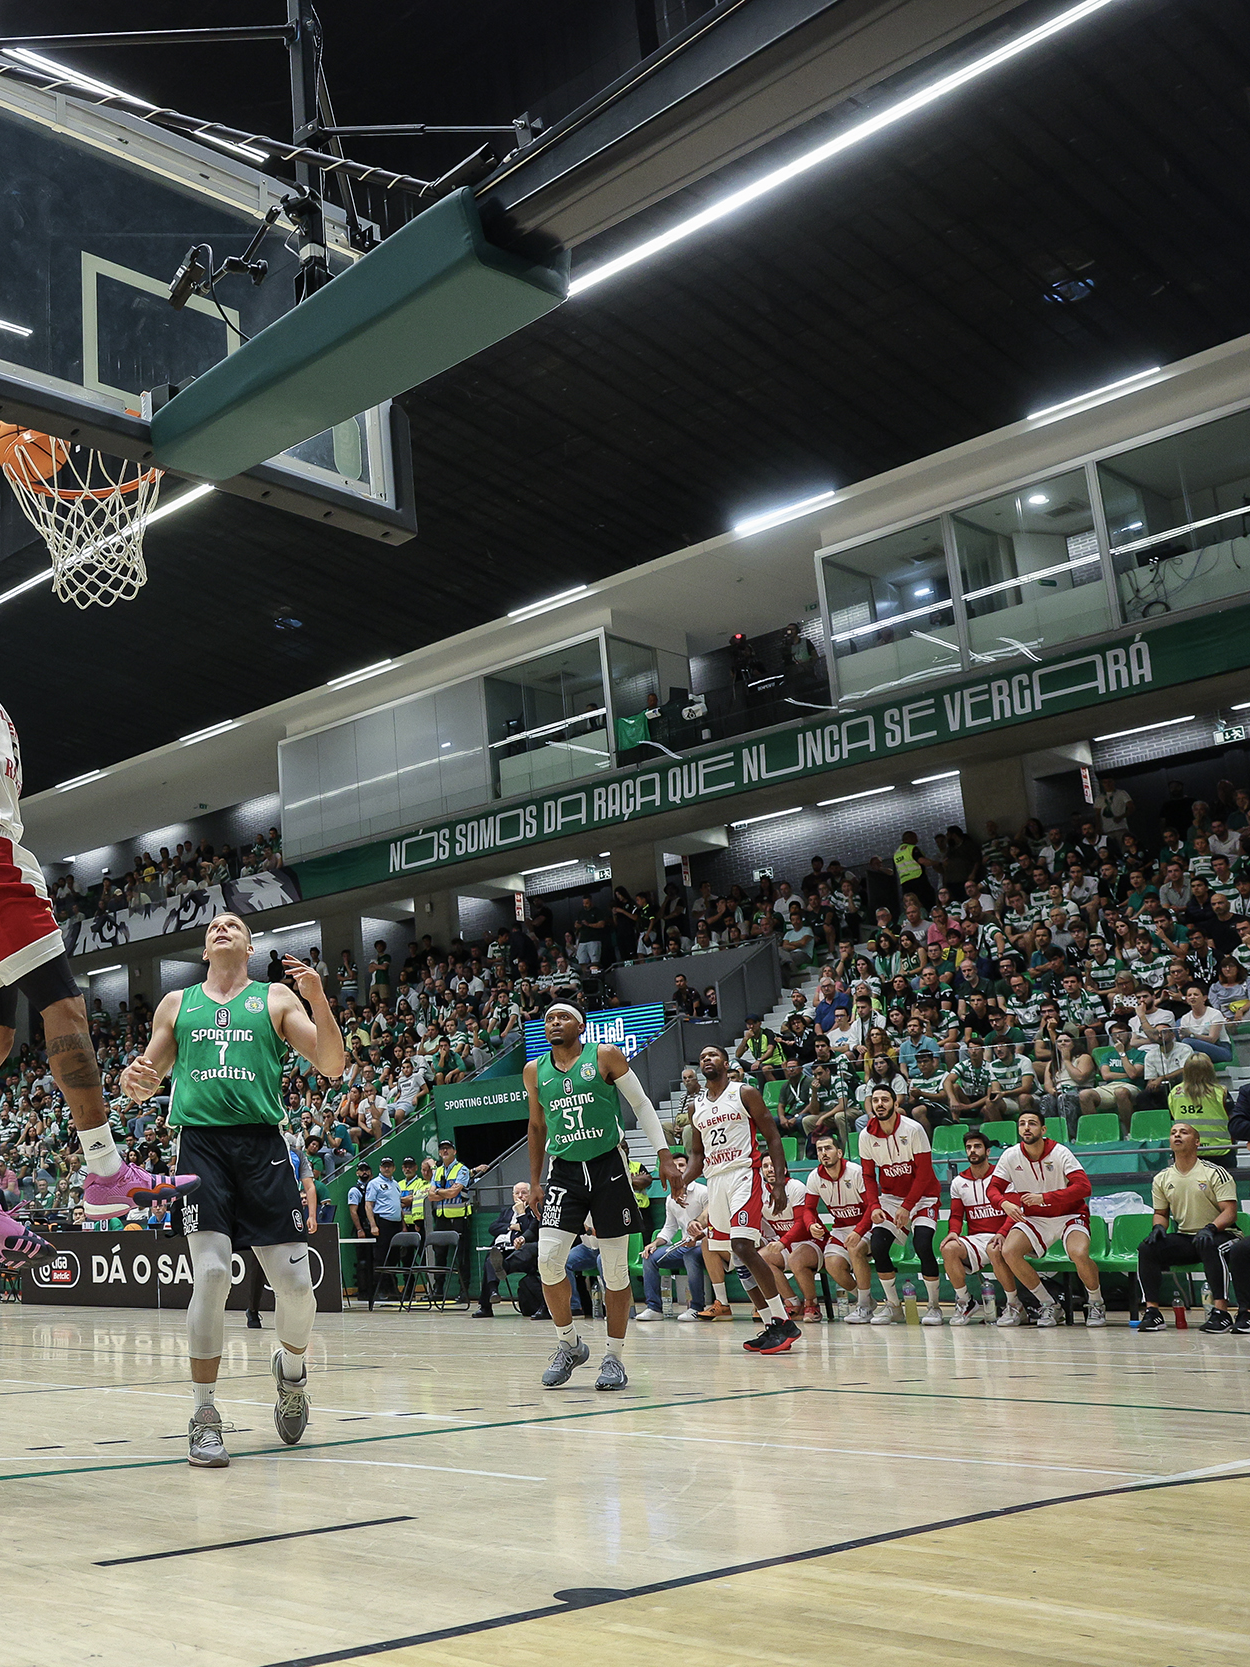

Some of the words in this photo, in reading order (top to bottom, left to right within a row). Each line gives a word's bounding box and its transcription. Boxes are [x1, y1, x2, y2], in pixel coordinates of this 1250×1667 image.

[389, 829, 449, 873] NÓS
[455, 805, 537, 855] SOMOS
[544, 791, 587, 834] DA
[594, 772, 660, 821] RAÇA
[667, 752, 735, 804] QUE
[742, 715, 876, 782] NUNCA
[884, 698, 937, 748] SE
[944, 633, 1153, 731] VERGARÁ
[191, 1028, 253, 1042] SPORTING
[214, 1041, 229, 1066] 7
[200, 1065, 256, 1082] auditiv
[444, 1097, 482, 1111] SPORTING
[483, 1093, 508, 1105] CLUBE
[509, 1091, 521, 1102] DE
[549, 1092, 594, 1112] SPORTING
[1180, 1105, 1204, 1115] 382
[562, 1106, 584, 1131] 57
[697, 1122, 706, 1130] SL
[706, 1112, 742, 1127] BENFICA
[562, 1128, 604, 1145] auditiv
[711, 1128, 727, 1146] 23
[545, 1185, 568, 1206] 57
[541, 1219, 560, 1227] DADE
[542, 1212, 561, 1220] QUILI
[92, 1243, 127, 1284] DÁ
[132, 1254, 152, 1284] O
[53, 1271, 70, 1280] Betclic
